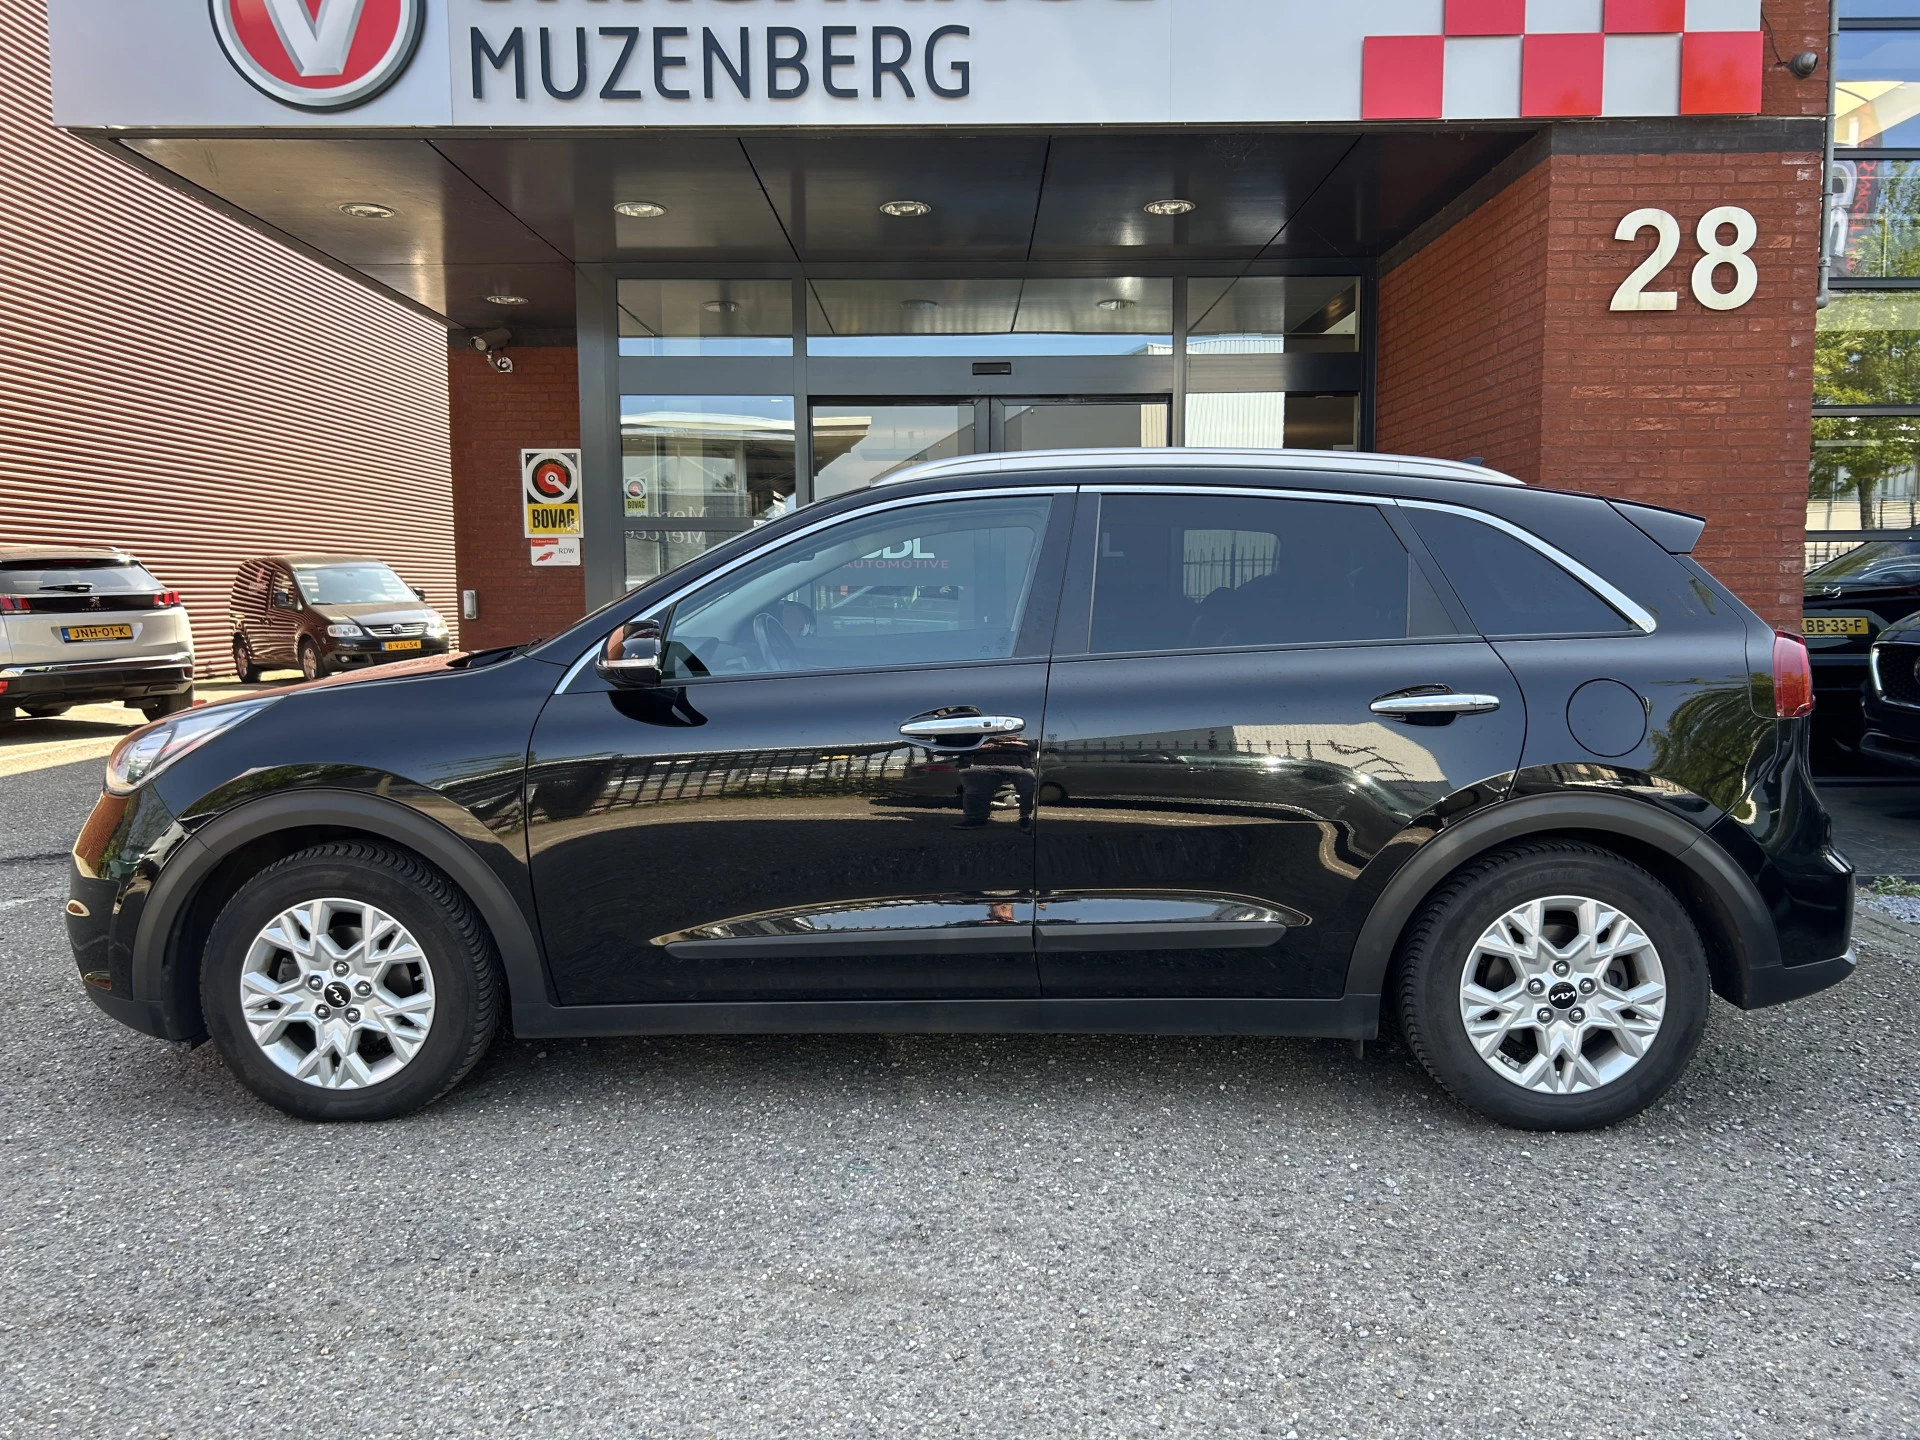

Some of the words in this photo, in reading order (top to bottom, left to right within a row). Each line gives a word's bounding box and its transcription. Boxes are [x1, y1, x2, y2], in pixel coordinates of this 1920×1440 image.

[471, 25, 972, 101] MUZENBERG
[1610, 206, 1758, 311] 28
[861, 537, 936, 559] DL
[842, 559, 949, 569] AUTOMOTIVE
[75, 627, 127, 638] JNH-01-K
